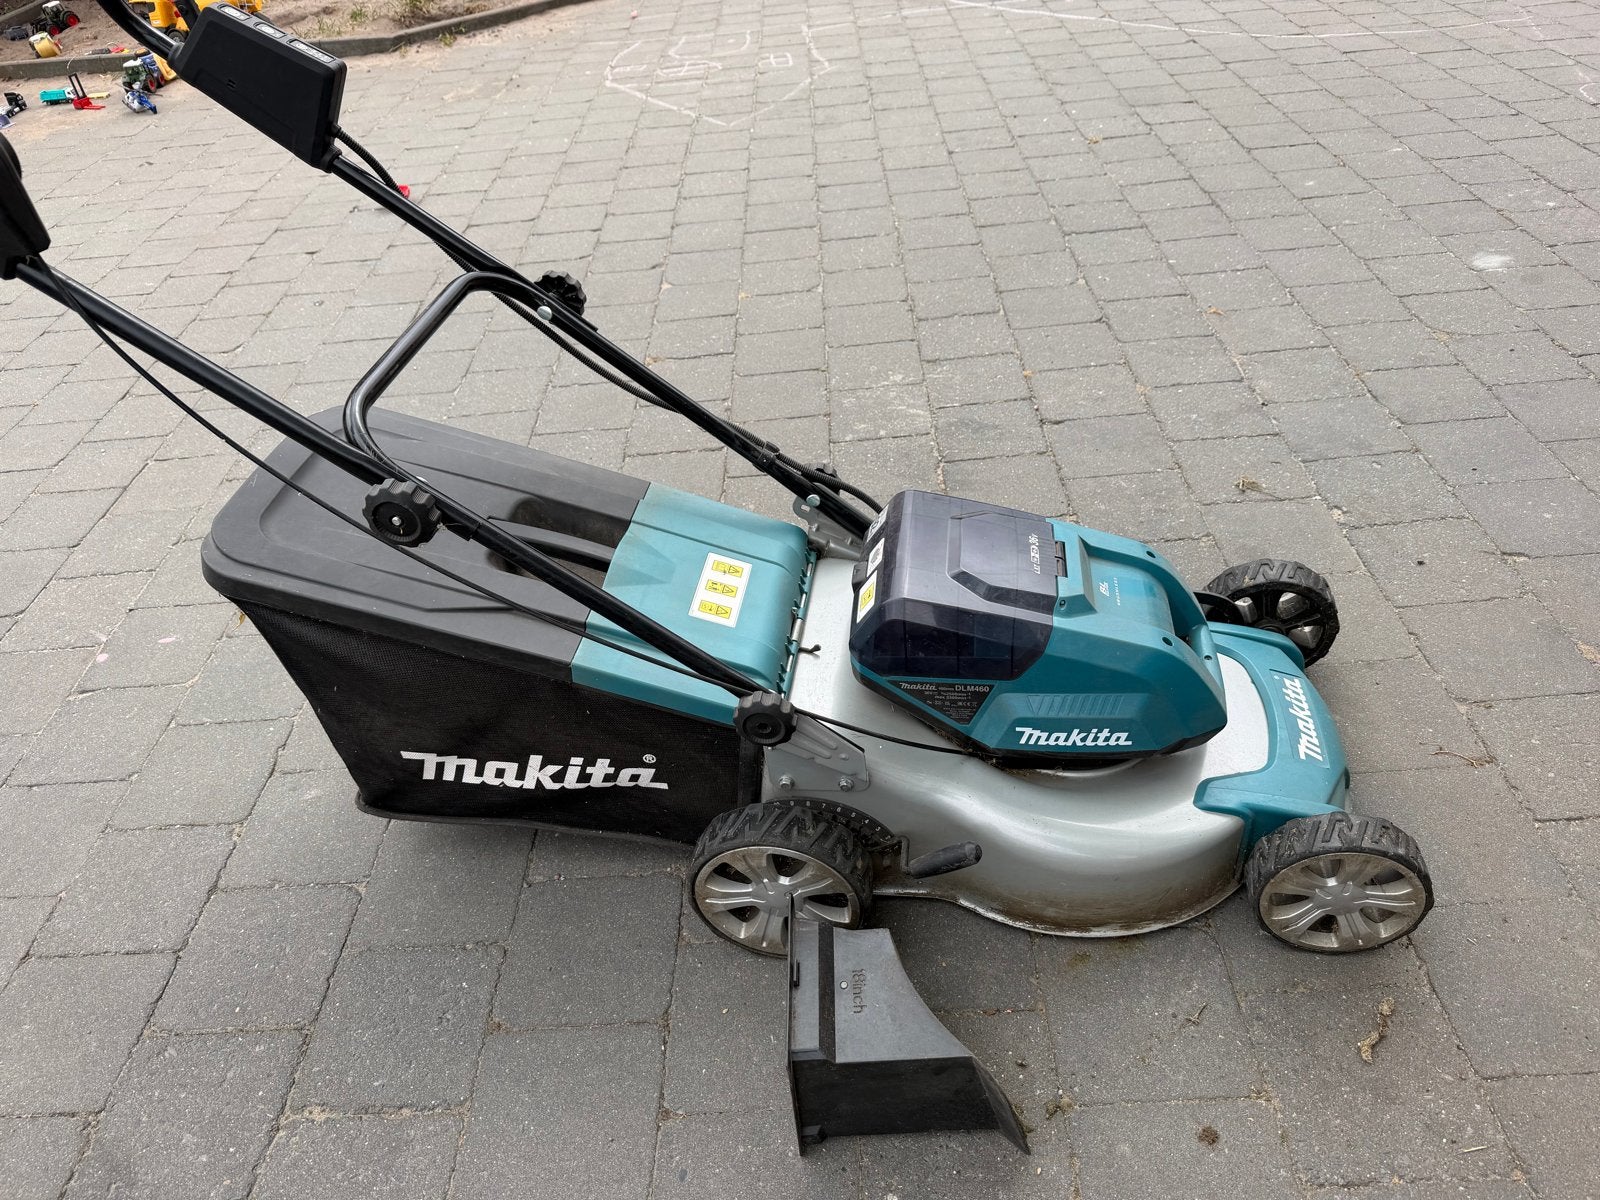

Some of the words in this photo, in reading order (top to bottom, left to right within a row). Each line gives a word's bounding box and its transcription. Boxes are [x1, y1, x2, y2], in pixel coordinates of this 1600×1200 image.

[955, 684, 990, 693] DLM460
[1015, 726, 1133, 748] makita
[852, 968, 868, 1014] 18inch
